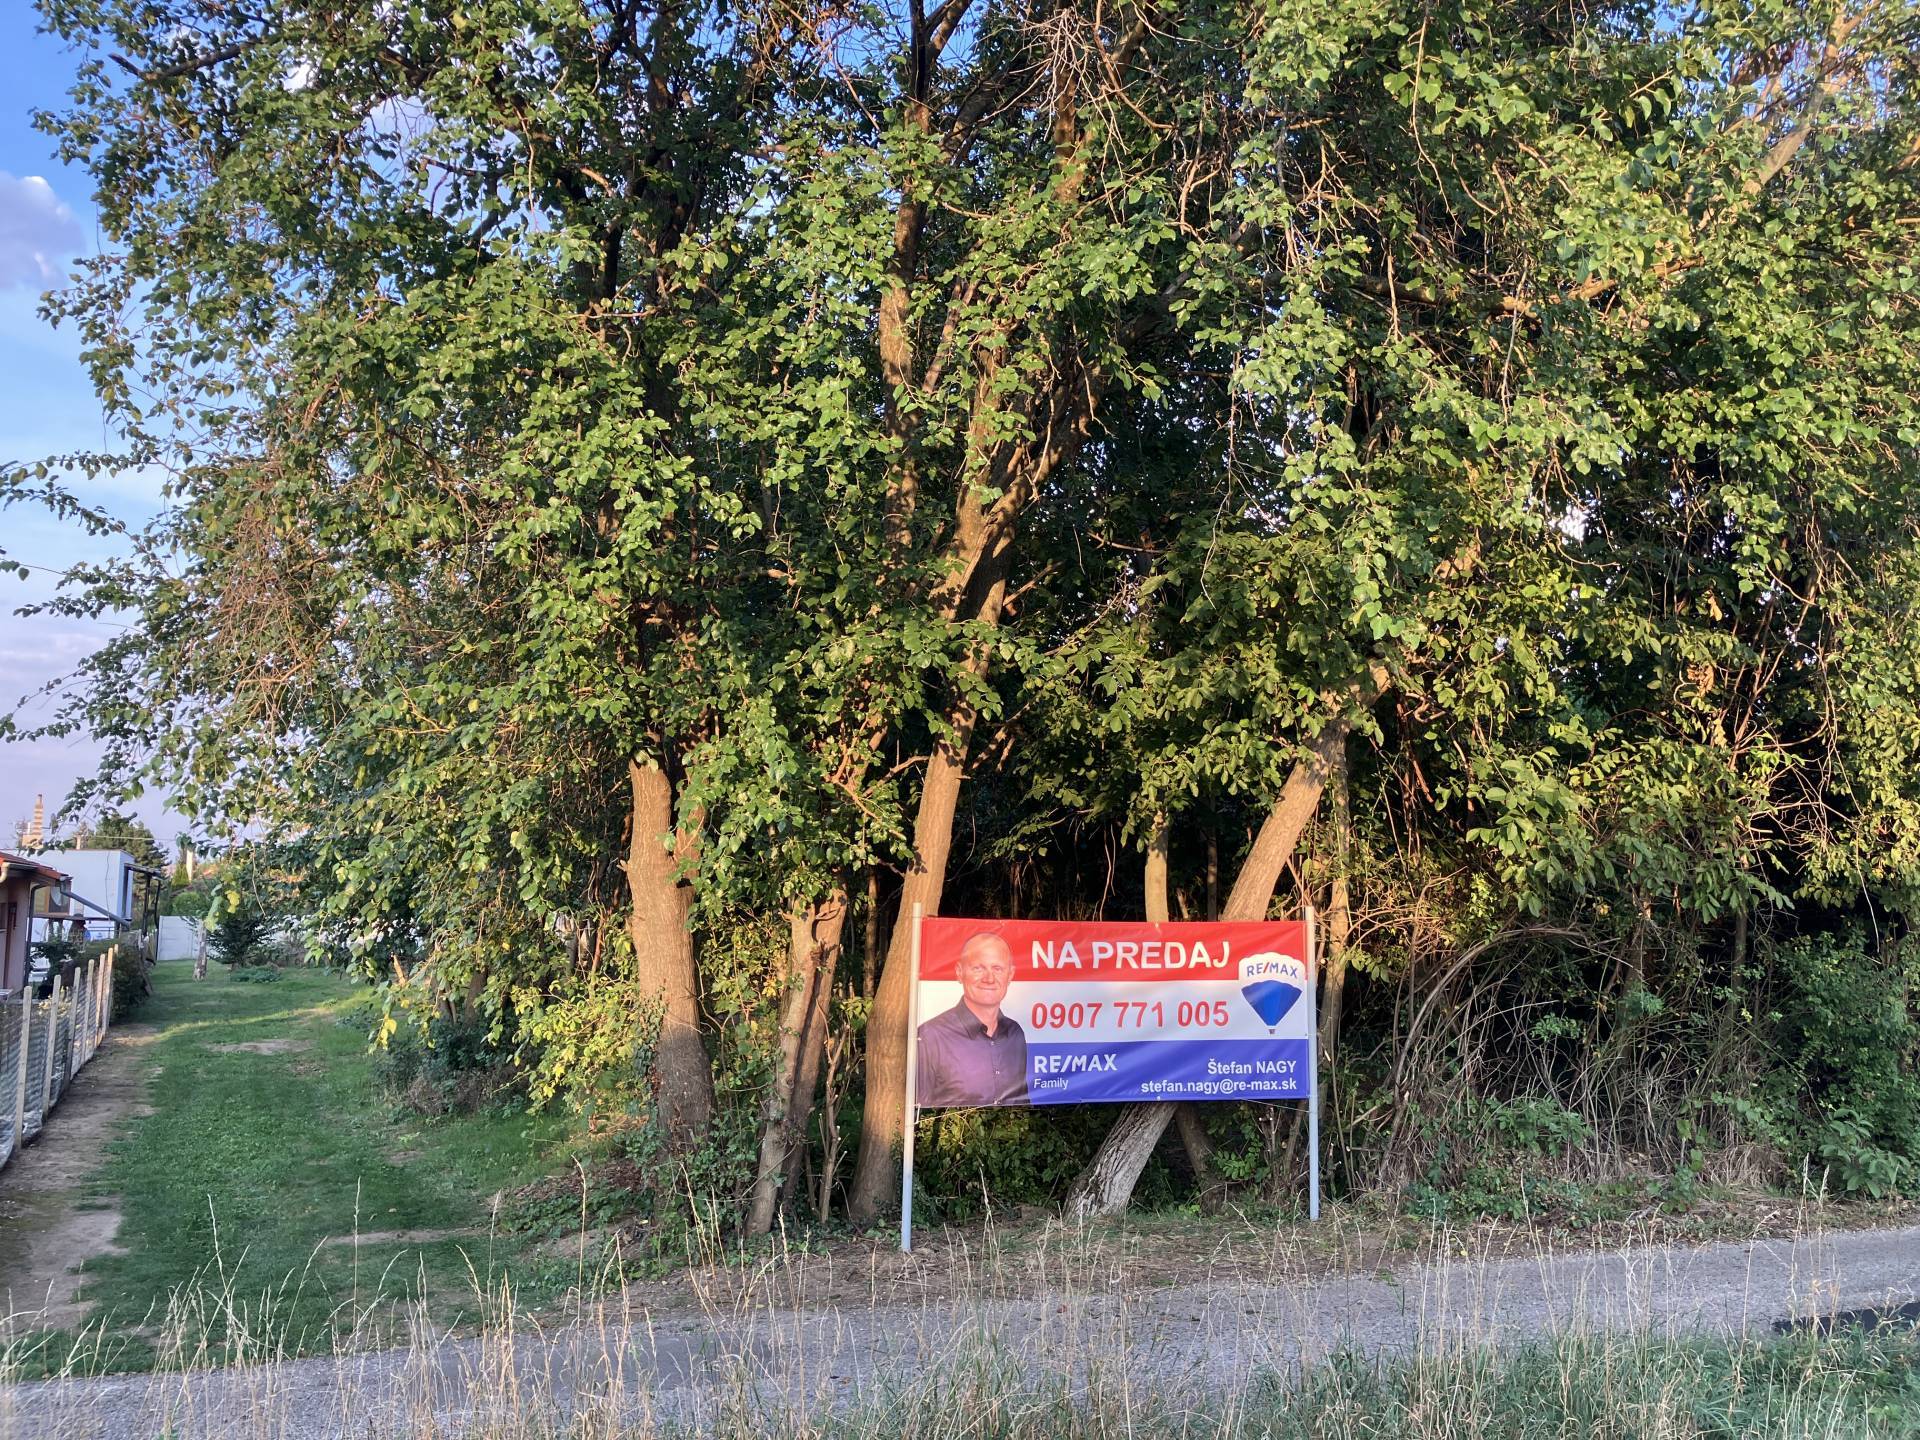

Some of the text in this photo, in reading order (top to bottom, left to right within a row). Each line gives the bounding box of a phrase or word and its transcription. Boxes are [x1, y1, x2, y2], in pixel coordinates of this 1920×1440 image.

[1031, 940, 1230, 969] NA PREDAJ
[1246, 963, 1299, 980] RE/MAX
[1031, 1001, 1229, 1029] 0907 771 005
[1034, 1053, 1118, 1074] RE/MAX
[1207, 1057, 1297, 1075] Štefan NAGY
[1033, 1077, 1069, 1090] Family
[1141, 1078, 1297, 1095] stefan.nagy@re-max.sk
